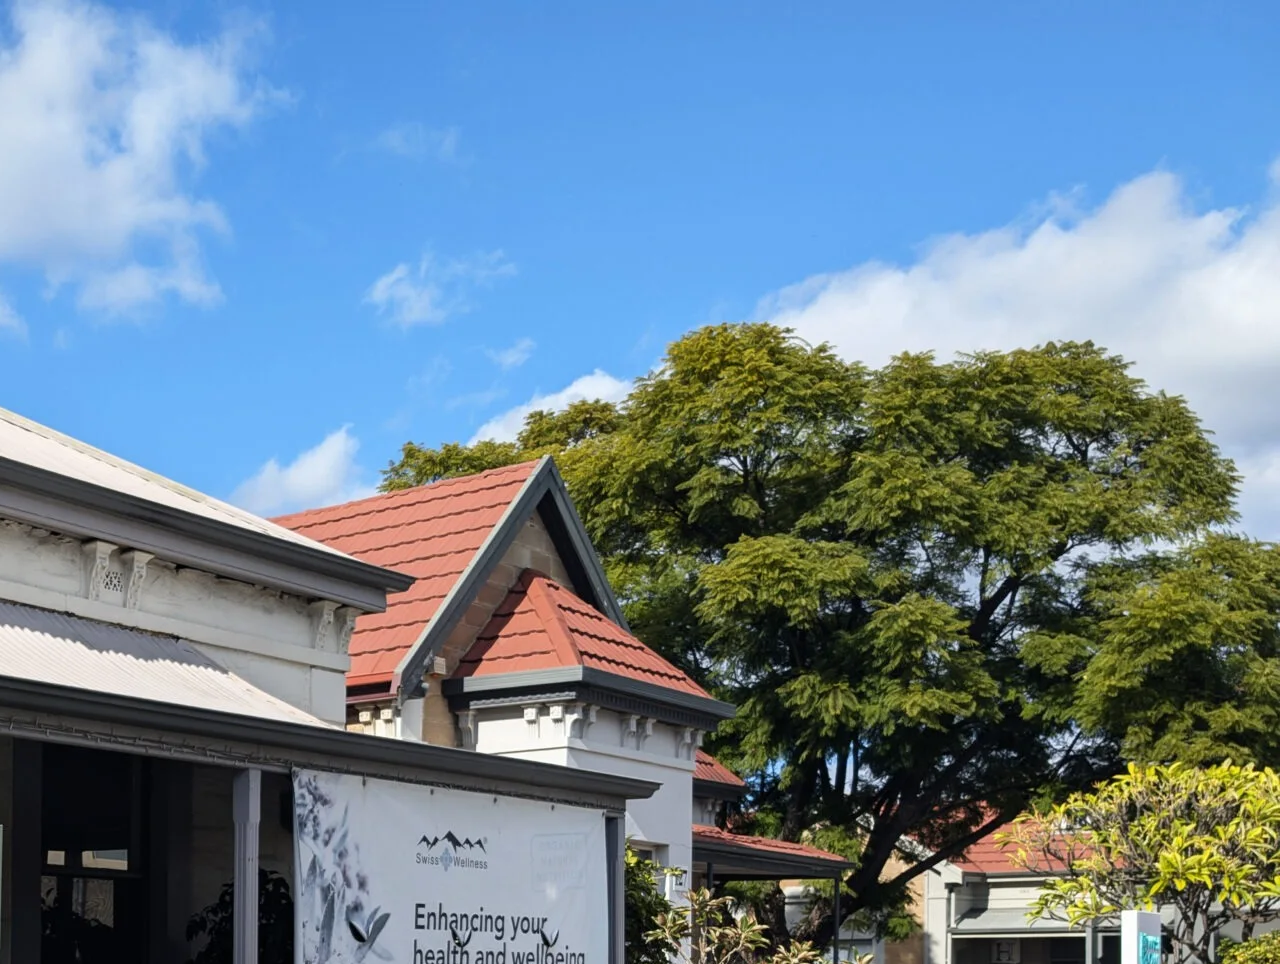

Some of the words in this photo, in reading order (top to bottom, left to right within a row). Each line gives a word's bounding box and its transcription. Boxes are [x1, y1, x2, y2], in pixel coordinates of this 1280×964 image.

[415, 852, 440, 866] Swiss
[453, 855, 488, 870] Wellness
[414, 902, 505, 941] Enhancing
[510, 916, 548, 941] your
